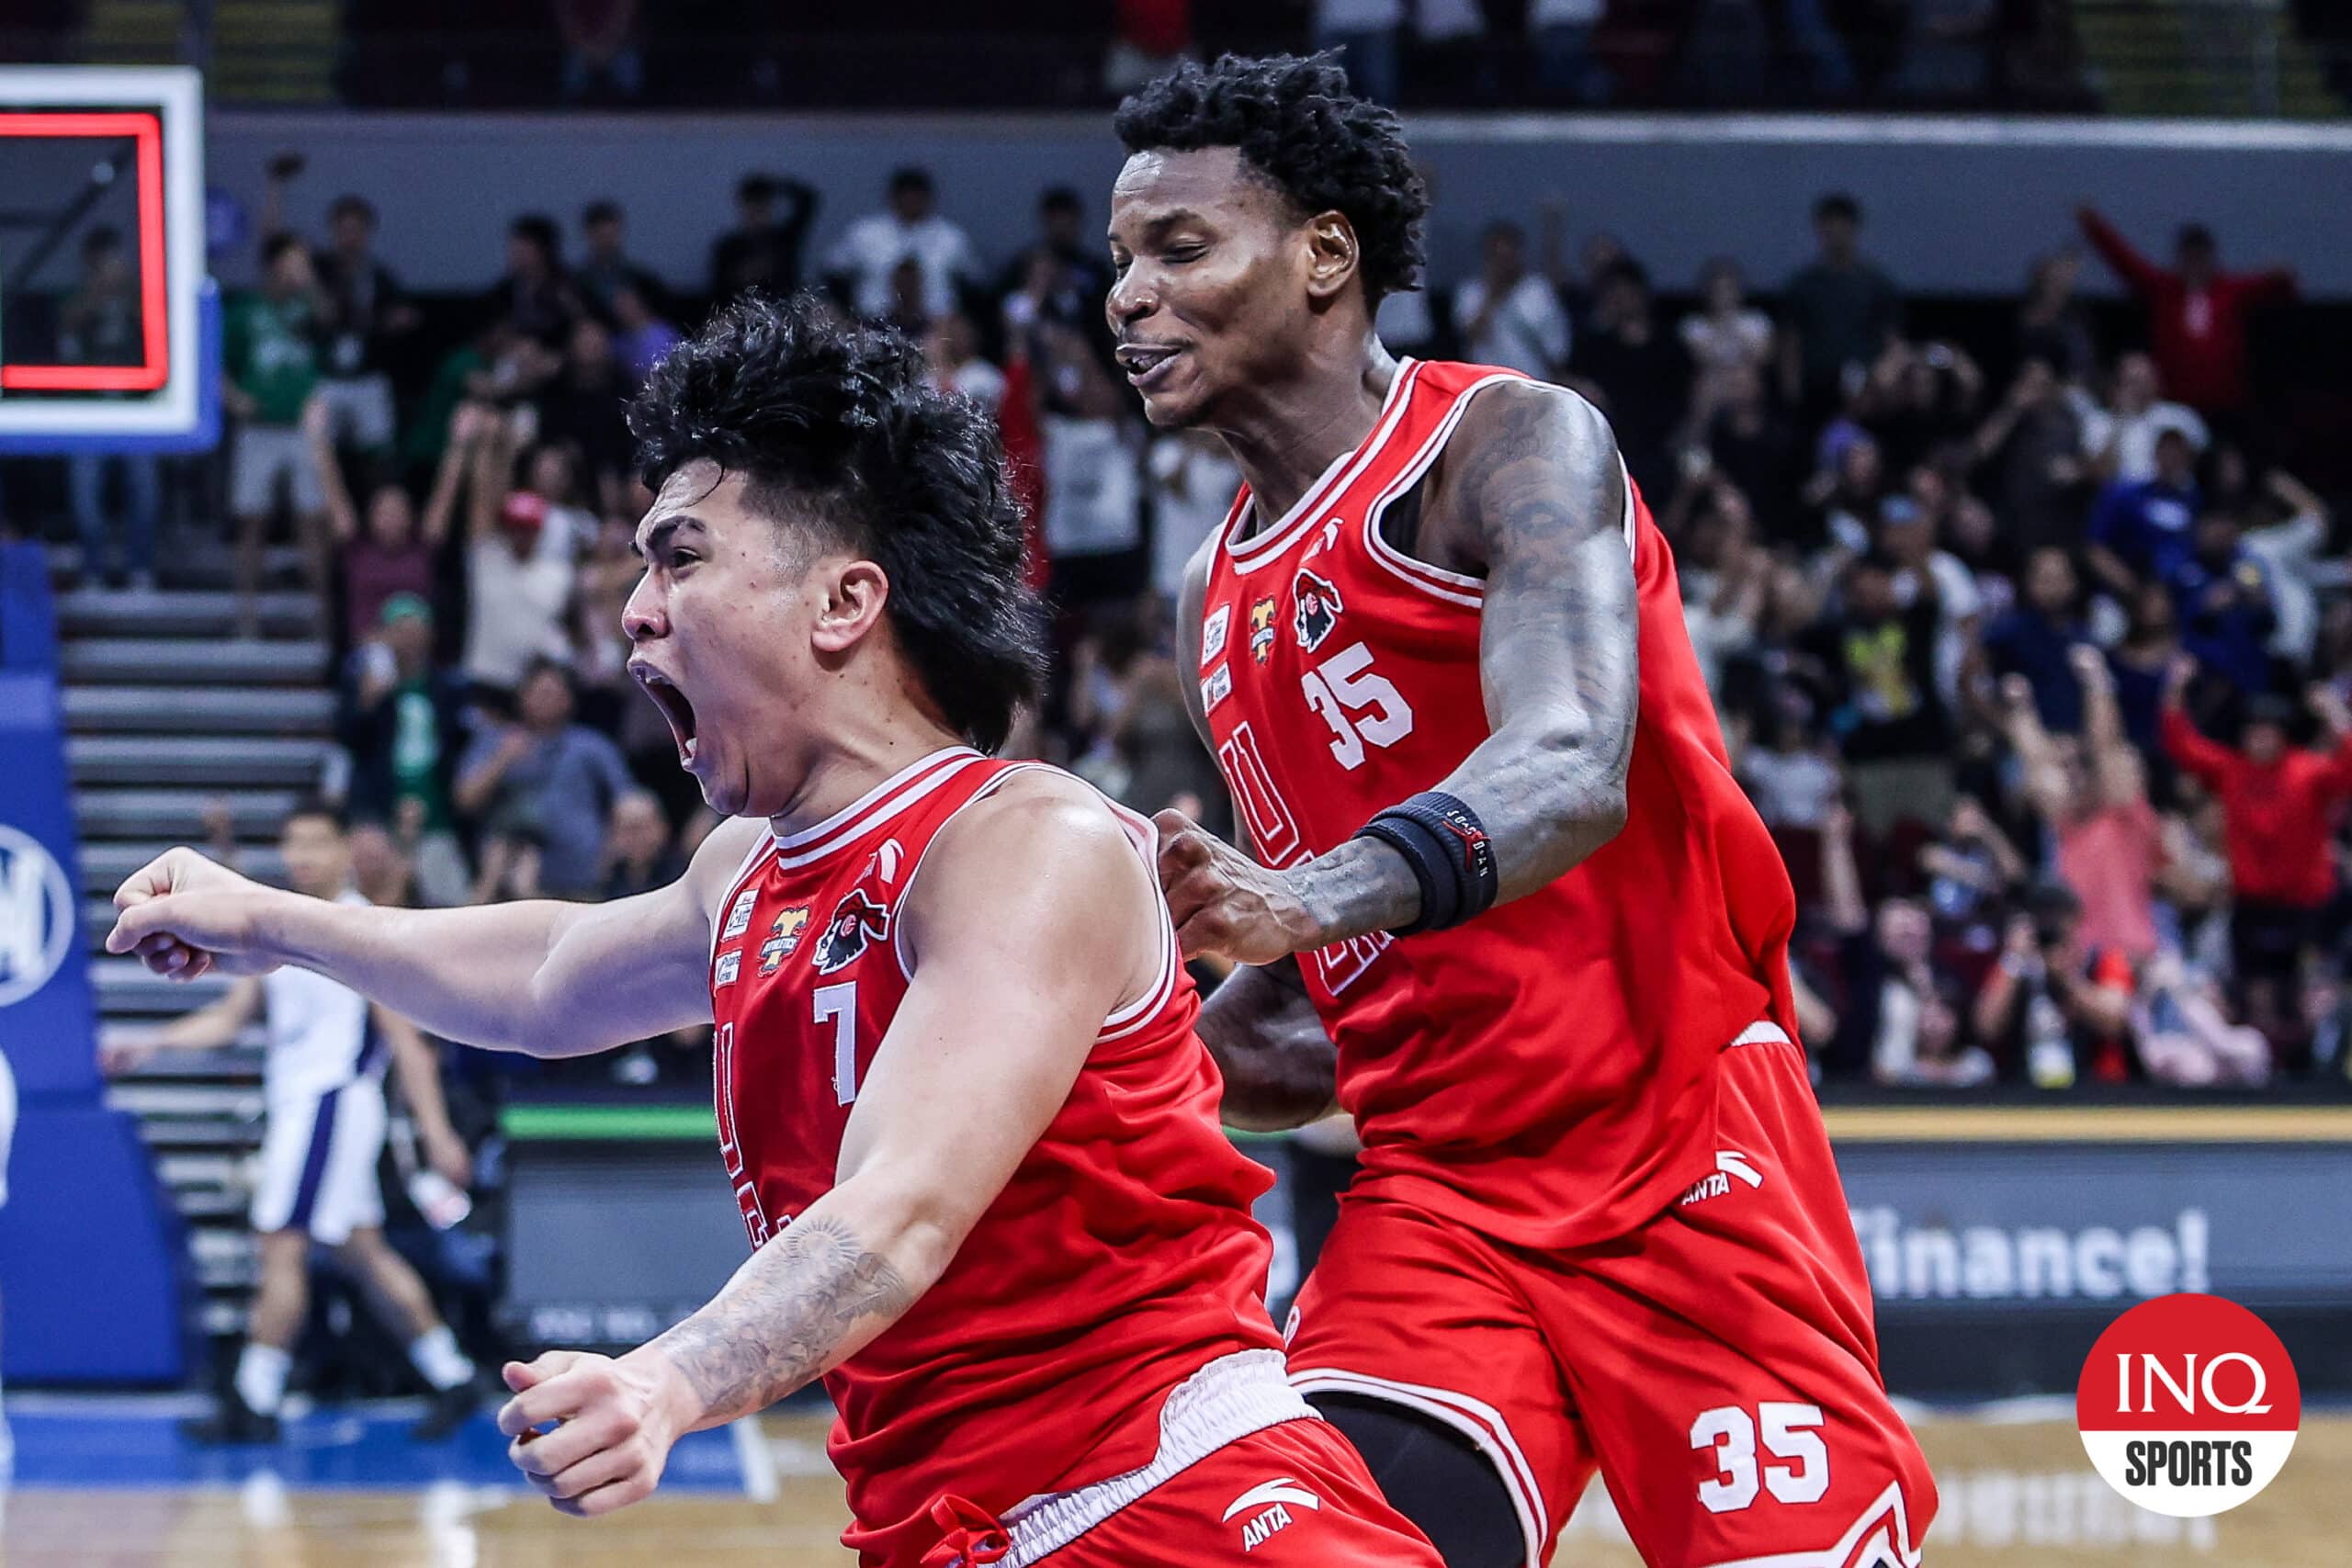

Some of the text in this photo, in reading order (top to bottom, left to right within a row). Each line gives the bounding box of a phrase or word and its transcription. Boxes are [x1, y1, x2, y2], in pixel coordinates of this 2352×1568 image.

[1301, 641, 1413, 771] 35
[813, 981, 856, 1107] 7
[1681, 1171, 1731, 1206] ANTA
[1690, 1401, 1830, 1514] 35
[1242, 1502, 1294, 1552] ANTA
